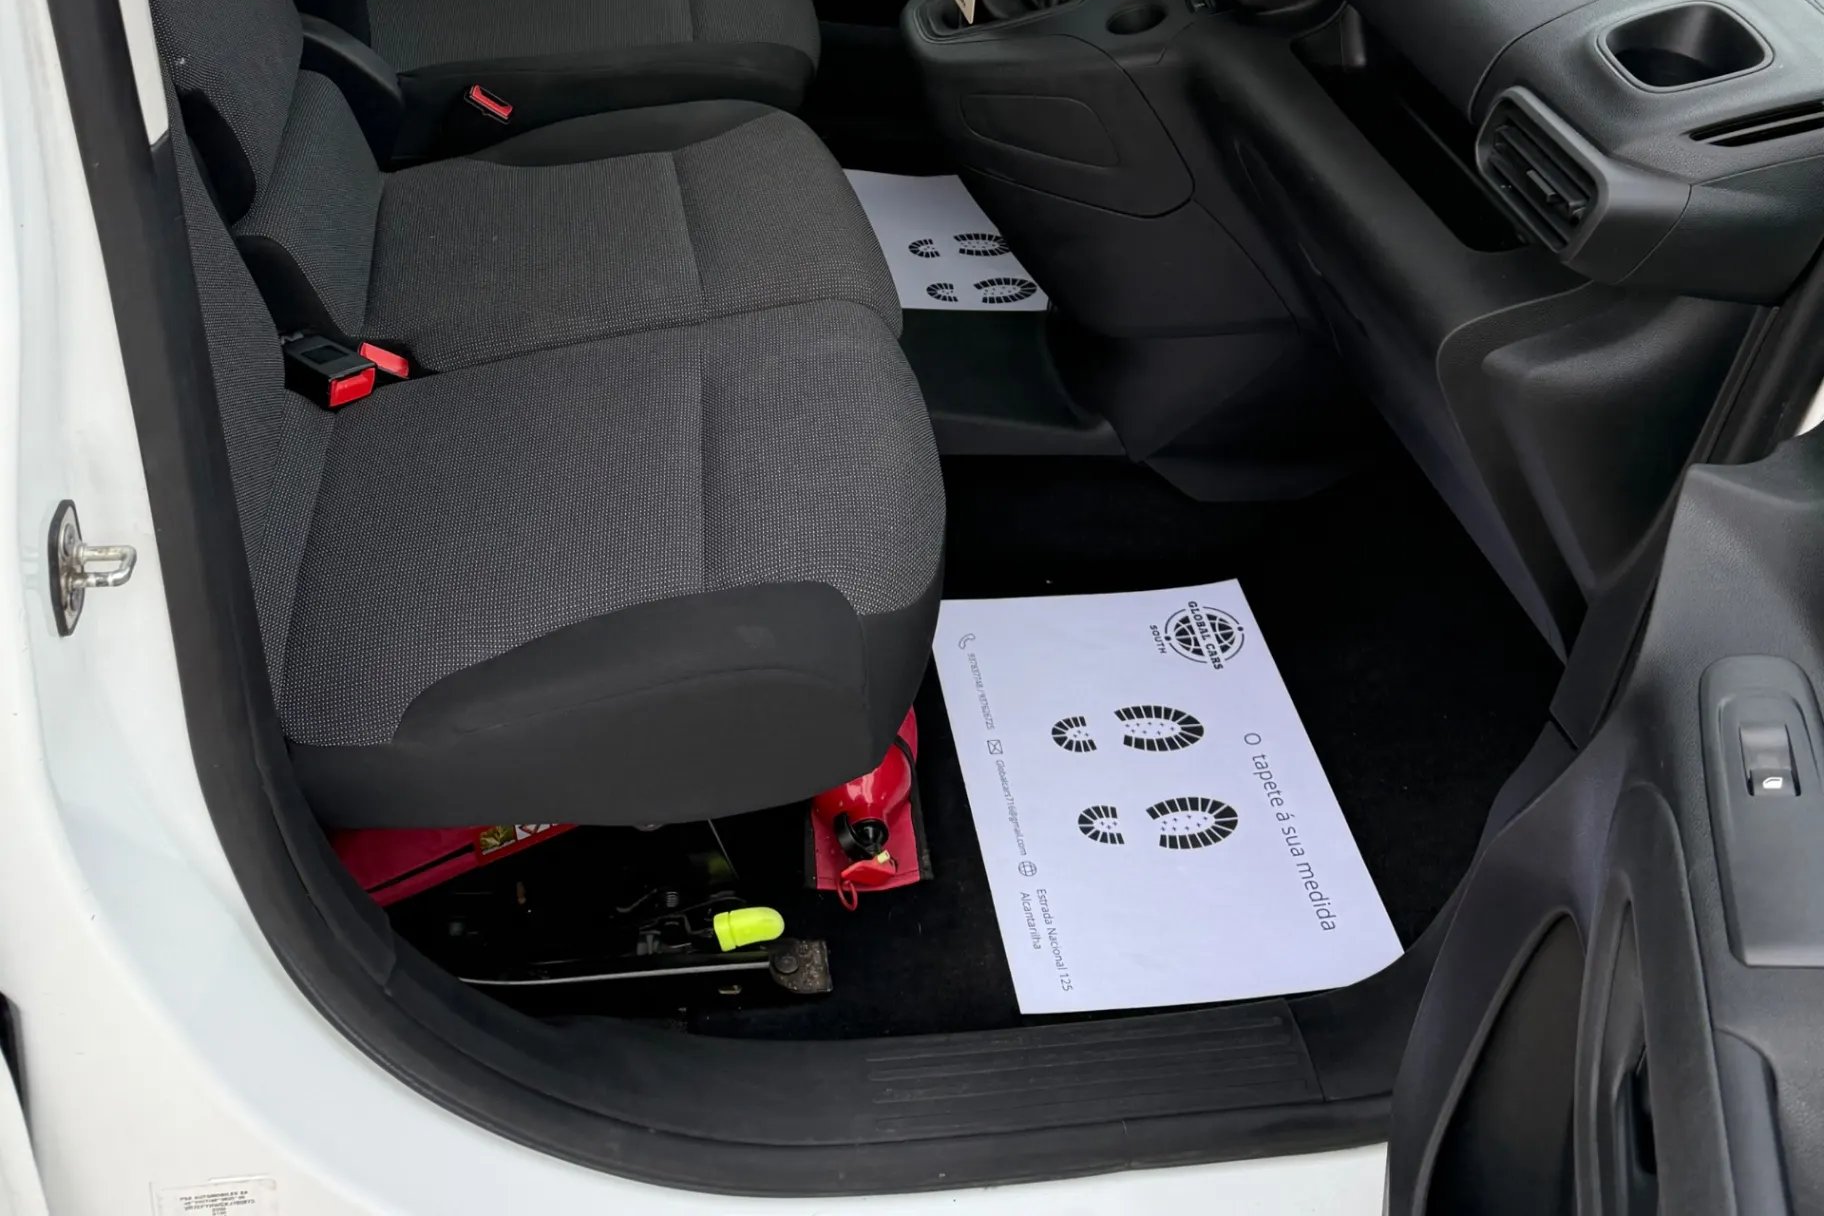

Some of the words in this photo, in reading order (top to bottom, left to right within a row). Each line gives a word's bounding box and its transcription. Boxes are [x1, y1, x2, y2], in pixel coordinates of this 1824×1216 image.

[1149, 624, 1167, 655] SOUTH
[1187, 601, 1211, 640] GLOBAL
[1205, 643, 1224, 670] CARS
[1243, 732, 1262, 746] O
[1252, 754, 1284, 807] tapete
[1276, 811, 1296, 822] á
[1281, 825, 1305, 857] sua
[1020, 891, 1042, 950] Alcantarilha
[1296, 861, 1337, 931] medida
[1036, 888, 1055, 925] Estrada
[1047, 927, 1068, 971] Nacional
[1059, 972, 1074, 992] 125
